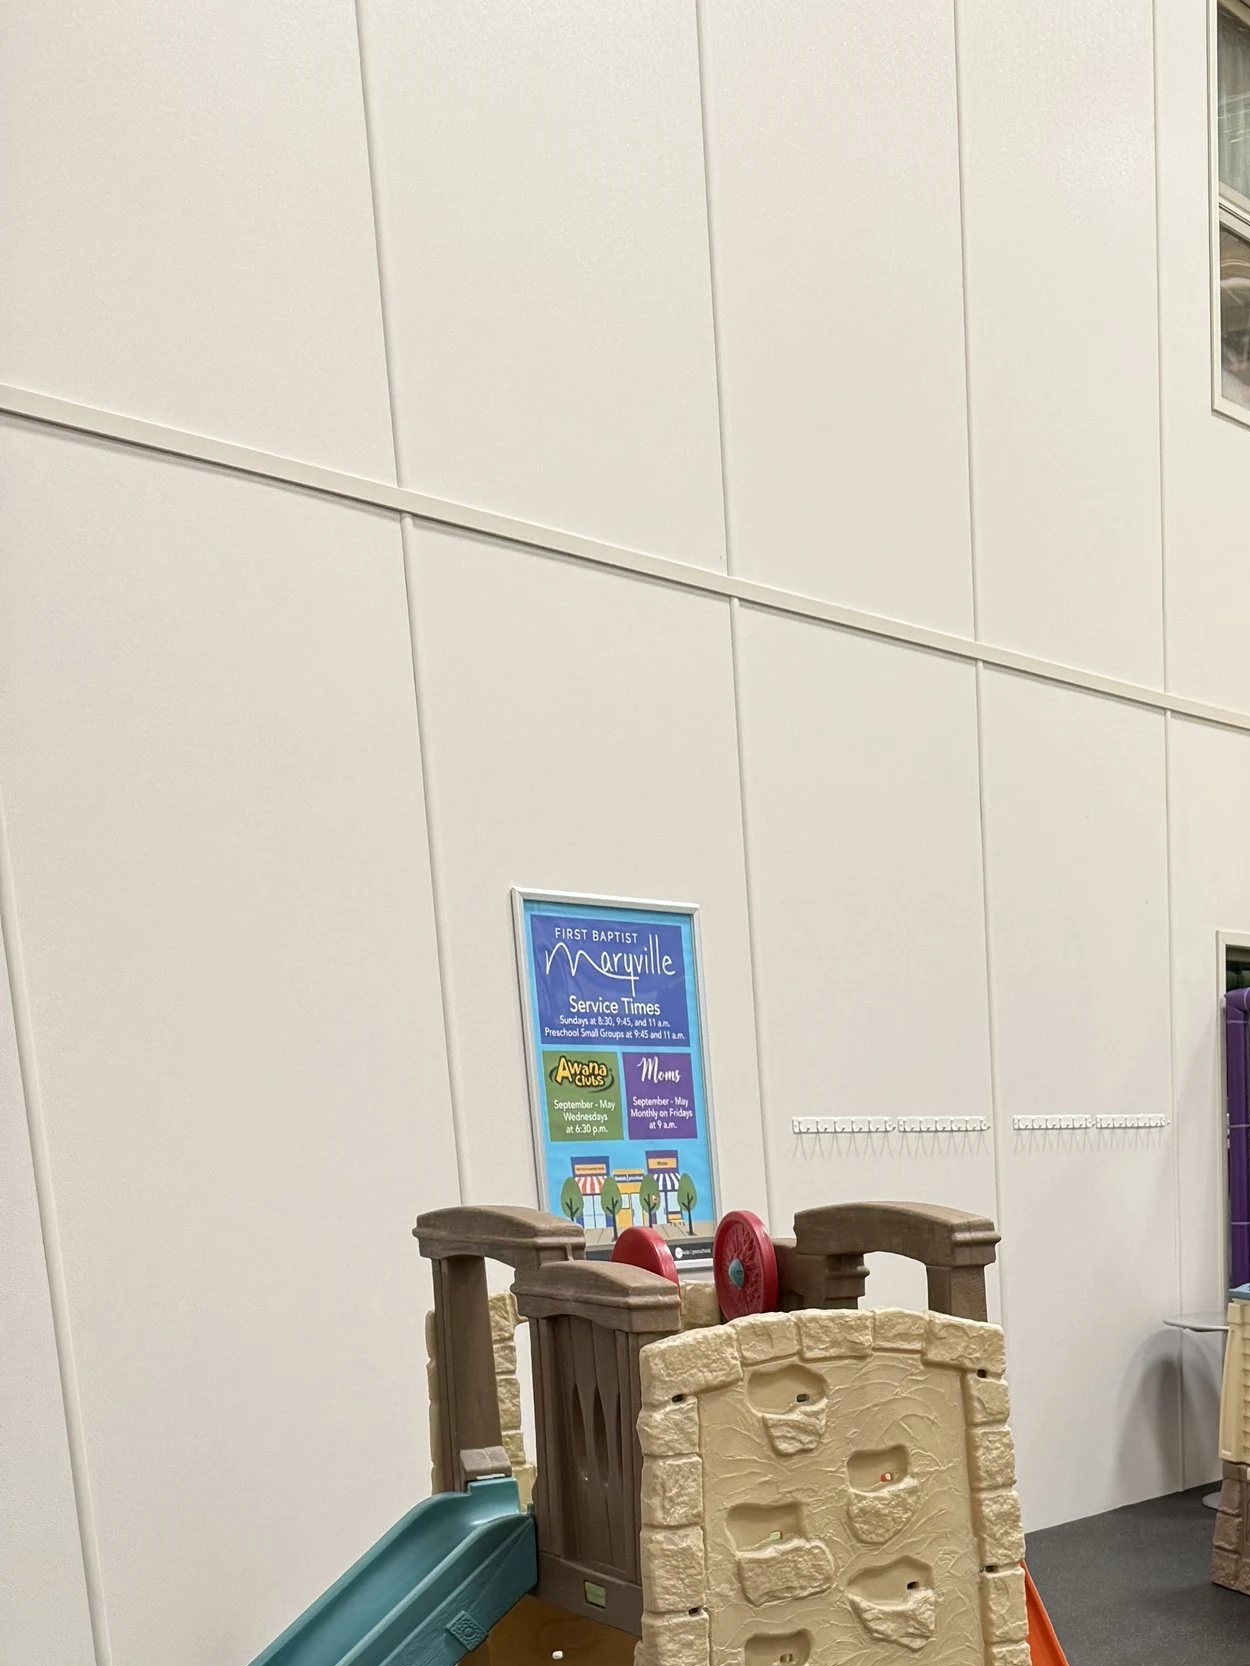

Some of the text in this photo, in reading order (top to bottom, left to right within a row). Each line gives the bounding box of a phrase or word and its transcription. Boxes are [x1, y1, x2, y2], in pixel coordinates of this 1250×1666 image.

[555, 928, 638, 943] FIRST BAPTIST
[545, 934, 676, 998] Maryville
[569, 995, 661, 1015] Service Times
[559, 1015, 671, 1028] Sundays at 8:30, 9:45, and 11 a.m.
[544, 1027, 686, 1040] Preschool Small Groups at 9:45 and 11 a.m.
[555, 1056, 608, 1085] Awana
[636, 1056, 682, 1083] Moms
[553, 1100, 593, 1111] September
[599, 1099, 616, 1111] May
[632, 1096, 669, 1108] September
[674, 1096, 689, 1107] May
[563, 1112, 608, 1123] Wednesdays
[630, 1108, 693, 1120] Monthly on Fridays
[566, 1124, 609, 1136] at 6:30 p.m.
[649, 1120, 678, 1130] at 9 a.m.
